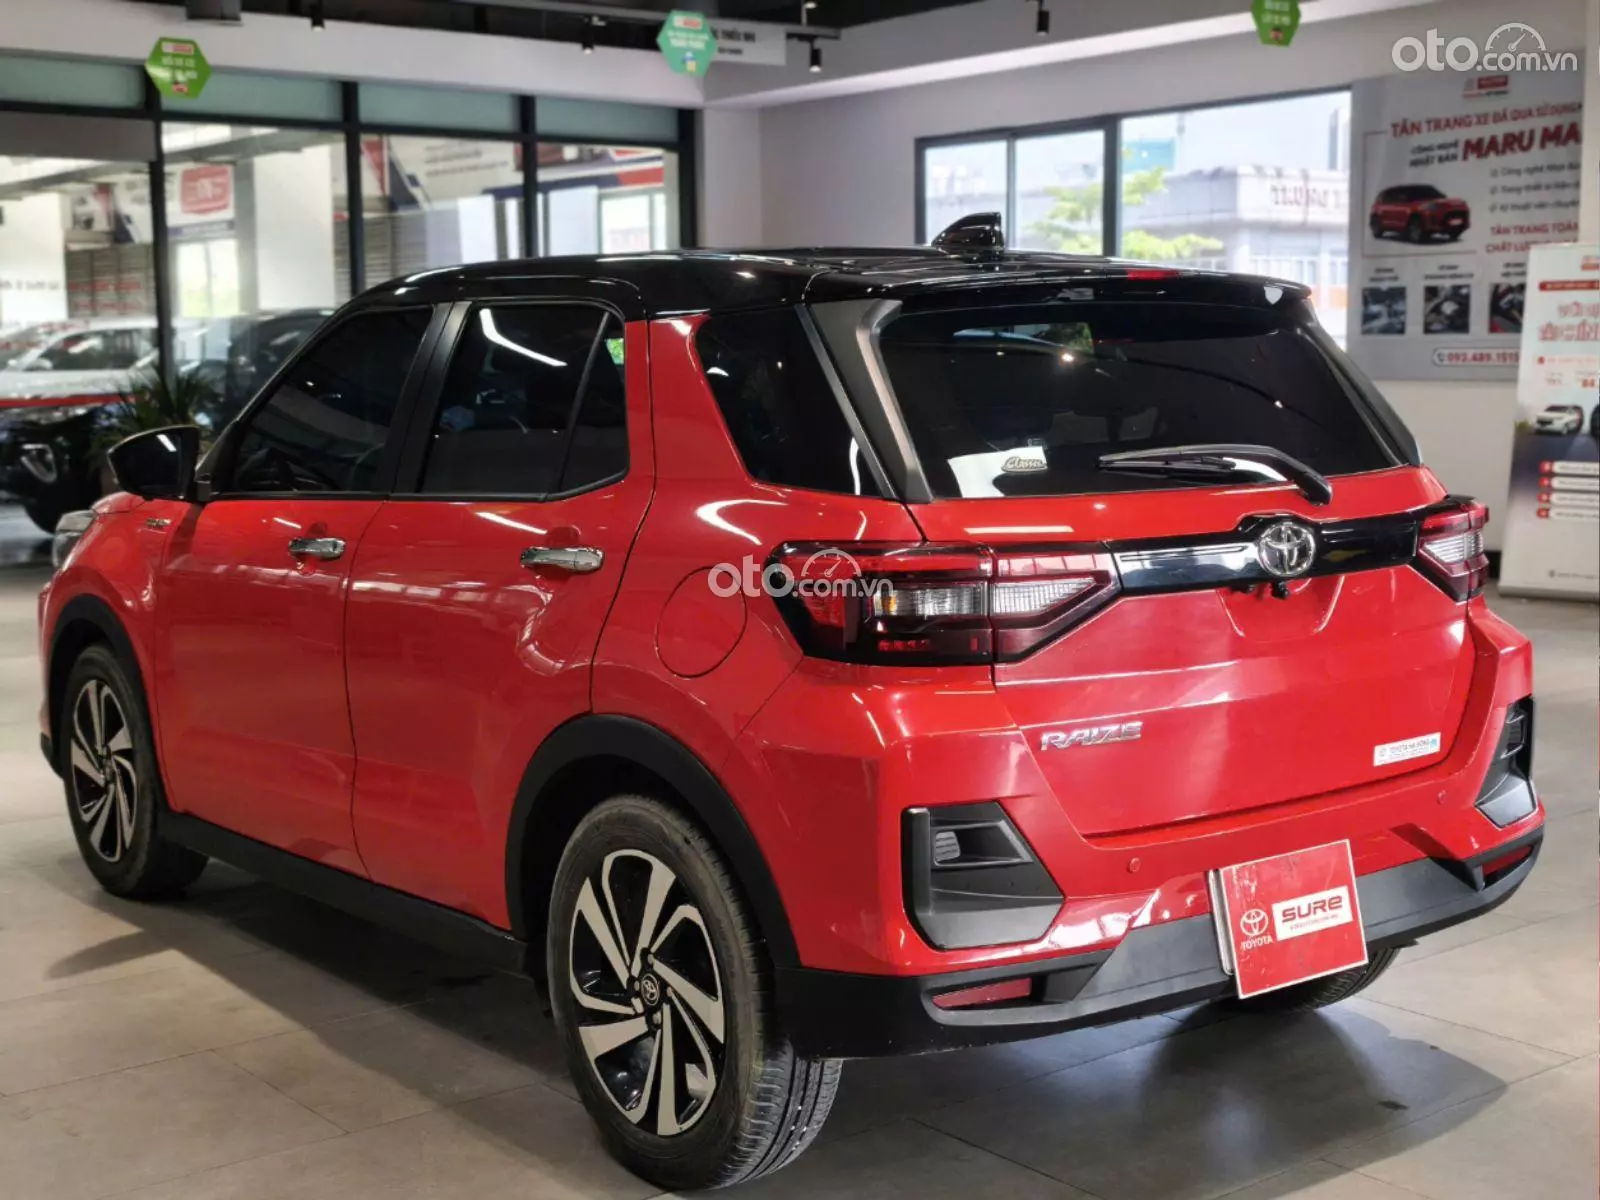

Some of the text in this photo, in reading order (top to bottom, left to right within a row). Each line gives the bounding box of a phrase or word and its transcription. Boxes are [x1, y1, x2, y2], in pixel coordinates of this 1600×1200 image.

[1425, 113, 1472, 133] TRANG
[1461, 129, 1536, 163] MARU
[1040, 721, 1143, 751] RAIZE
[1241, 935, 1274, 950] TOYOTA
